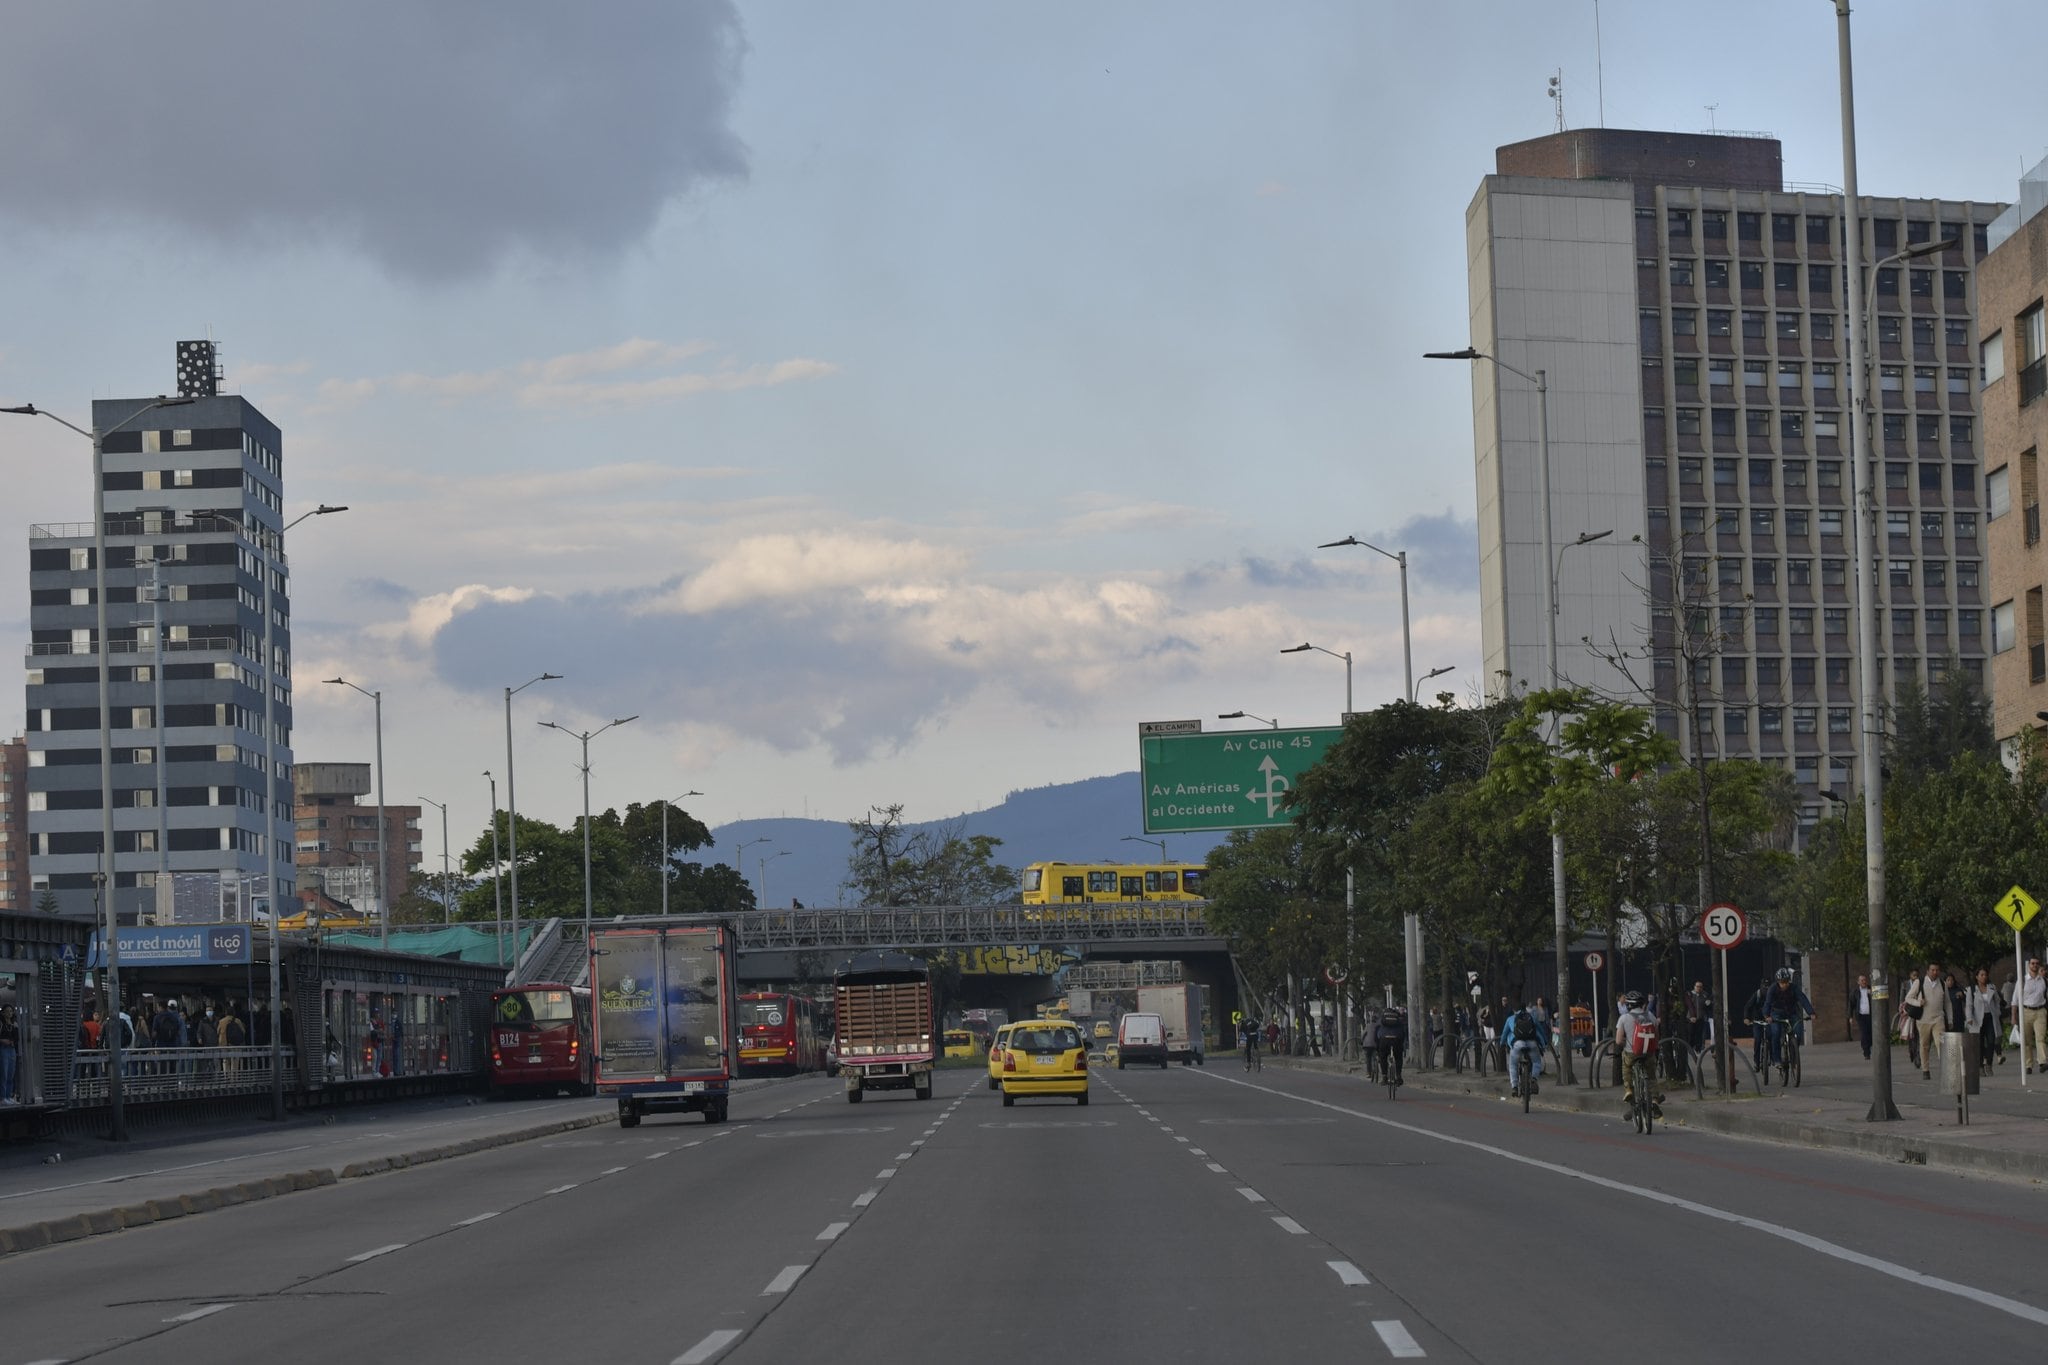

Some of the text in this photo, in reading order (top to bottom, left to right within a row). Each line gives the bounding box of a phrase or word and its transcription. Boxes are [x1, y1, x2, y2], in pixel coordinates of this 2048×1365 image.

[1223, 736, 1312, 752] Av Calle 45
[1151, 782, 1240, 796] Av Américas
[1152, 803, 1235, 816] al Occidente
[1710, 916, 1737, 936] 50
[93, 934, 201, 951] mor red móvil
[62, 945, 75, 960] A
[399, 973, 405, 983] 3
